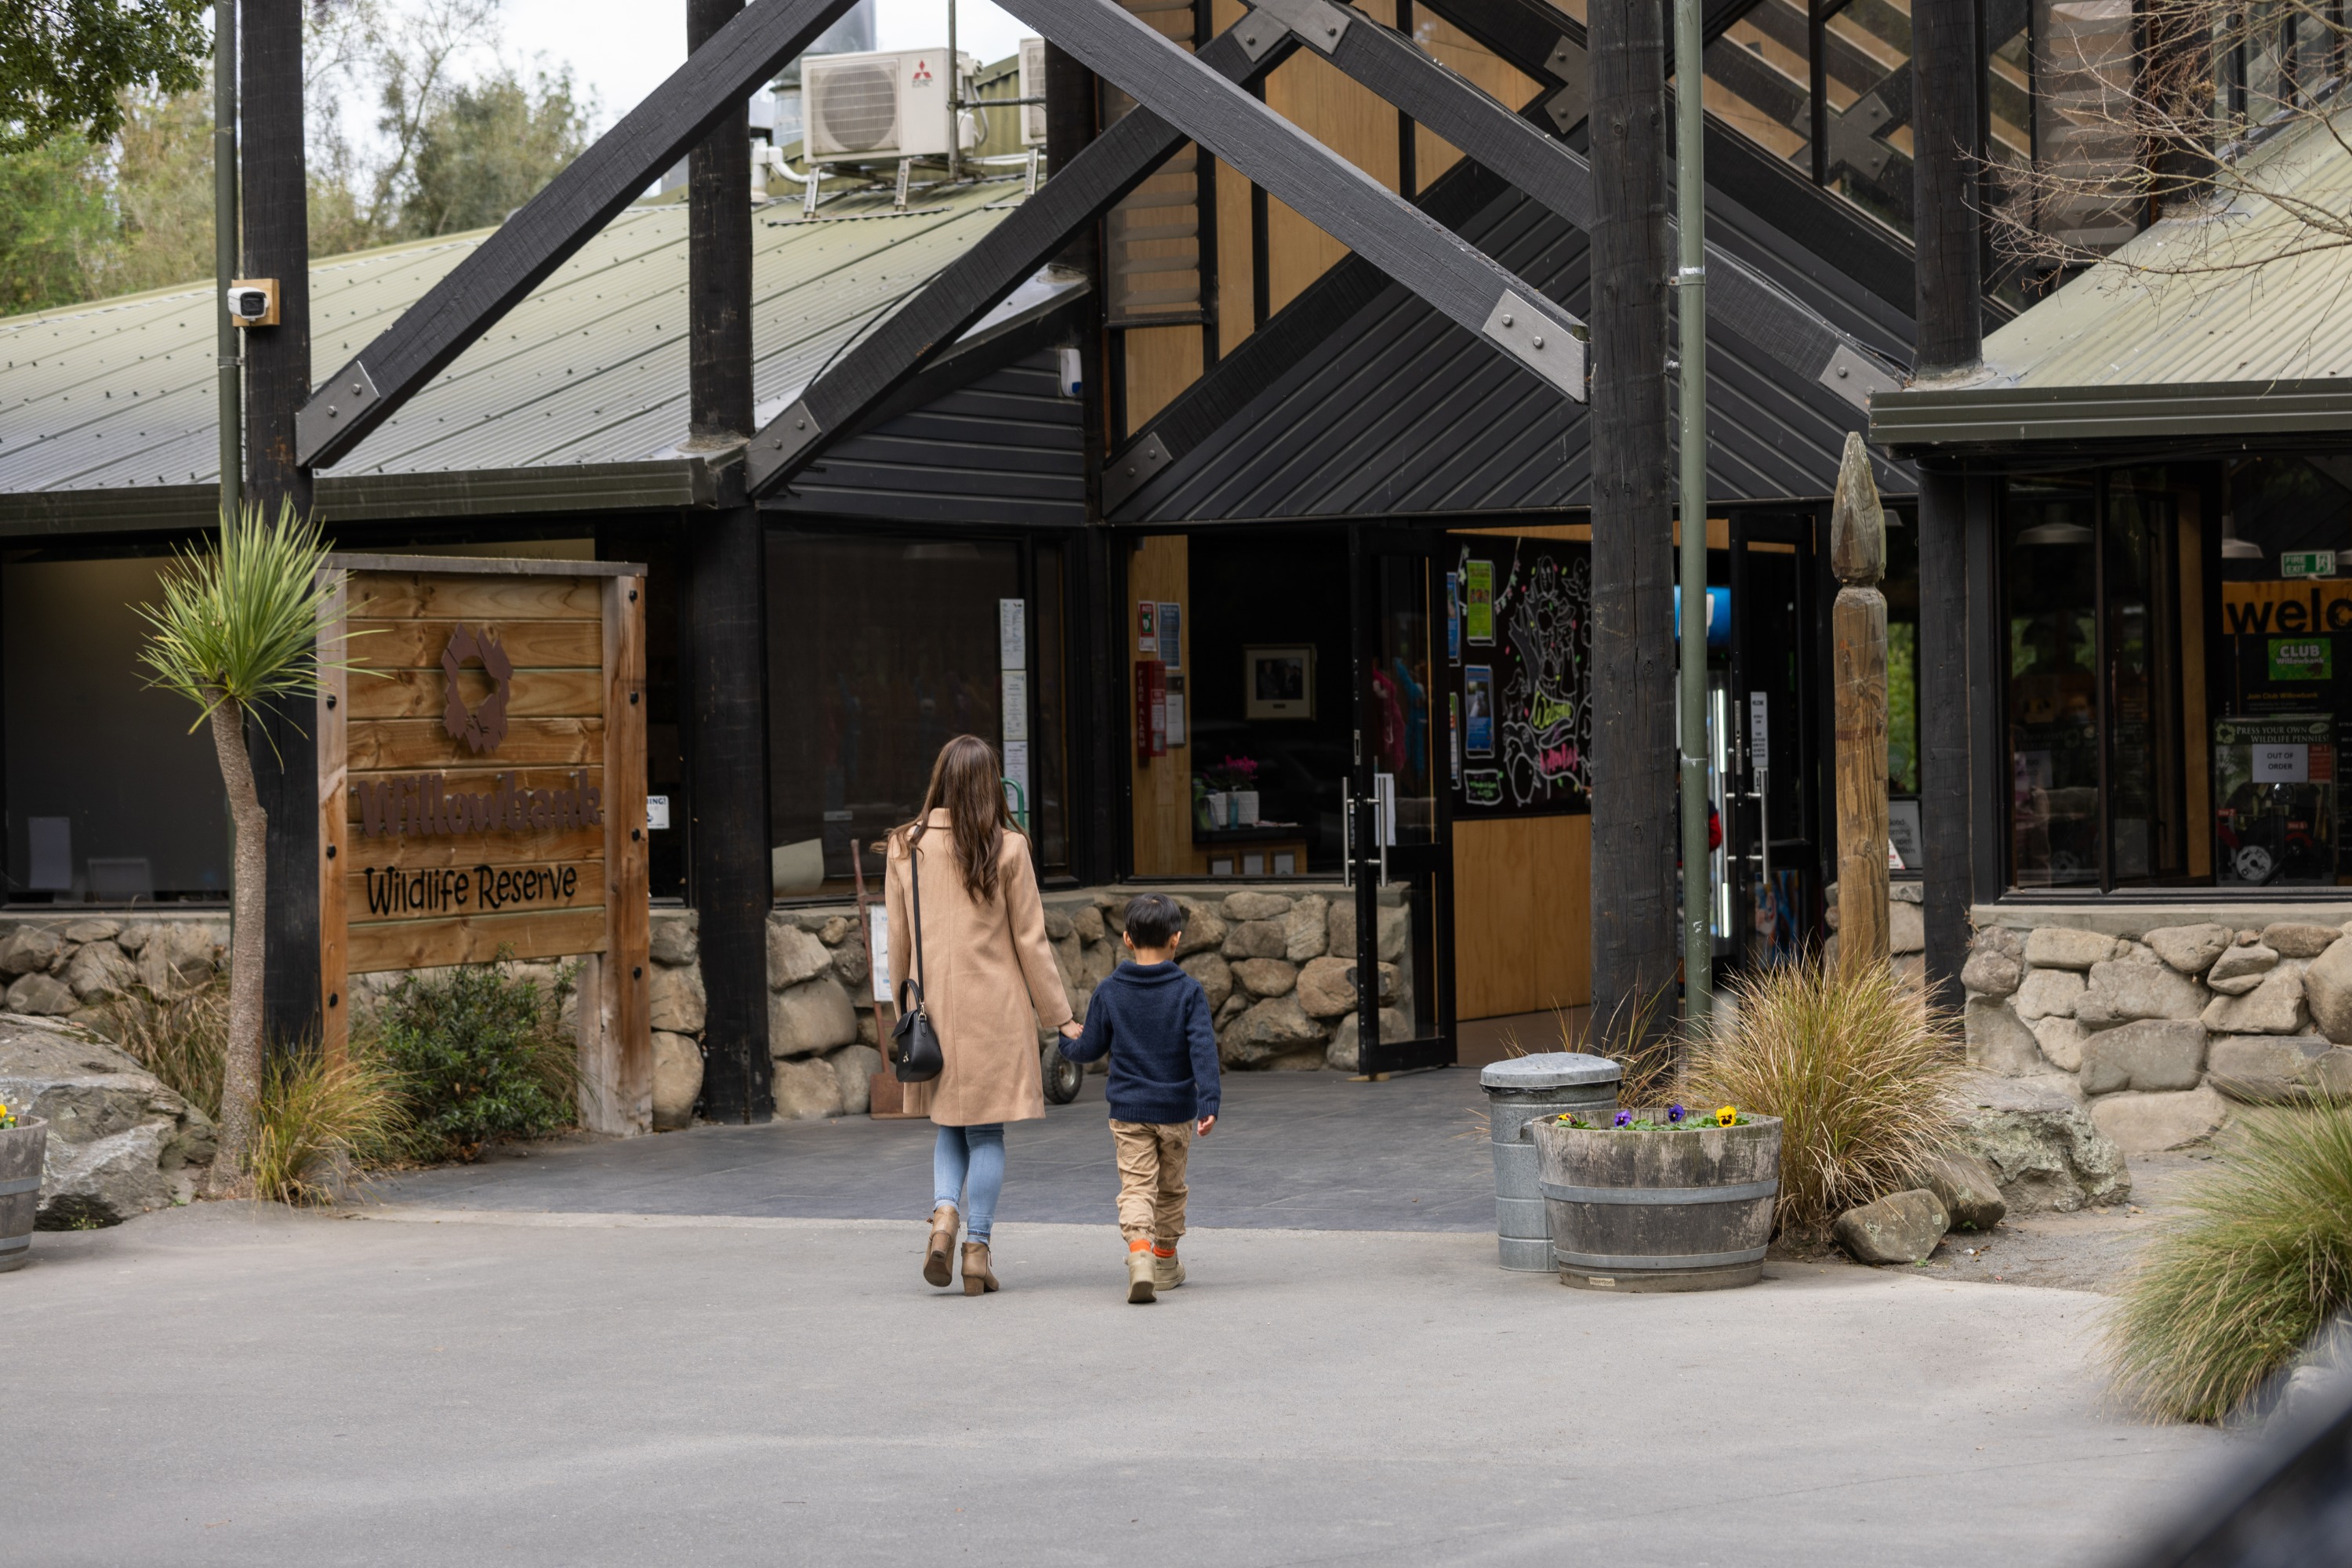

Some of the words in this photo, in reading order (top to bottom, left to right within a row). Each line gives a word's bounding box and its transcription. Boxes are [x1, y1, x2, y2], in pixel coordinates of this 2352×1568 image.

[2285, 555, 2306, 564] FIRE
[2285, 564, 2306, 573] EXIT
[2226, 588, 2352, 633] welc
[2280, 644, 2321, 657] CLUB
[2236, 726, 2259, 735] PRESS
[2262, 726, 2285, 735] YOUR
[2286, 725, 2307, 734] OWN
[2250, 735, 2290, 743] WILDLIFE
[2292, 734, 2329, 742] PENNIES!
[358, 768, 601, 838] Willowbank
[365, 866, 469, 915] Wildlife
[474, 865, 577, 909] Reserve
